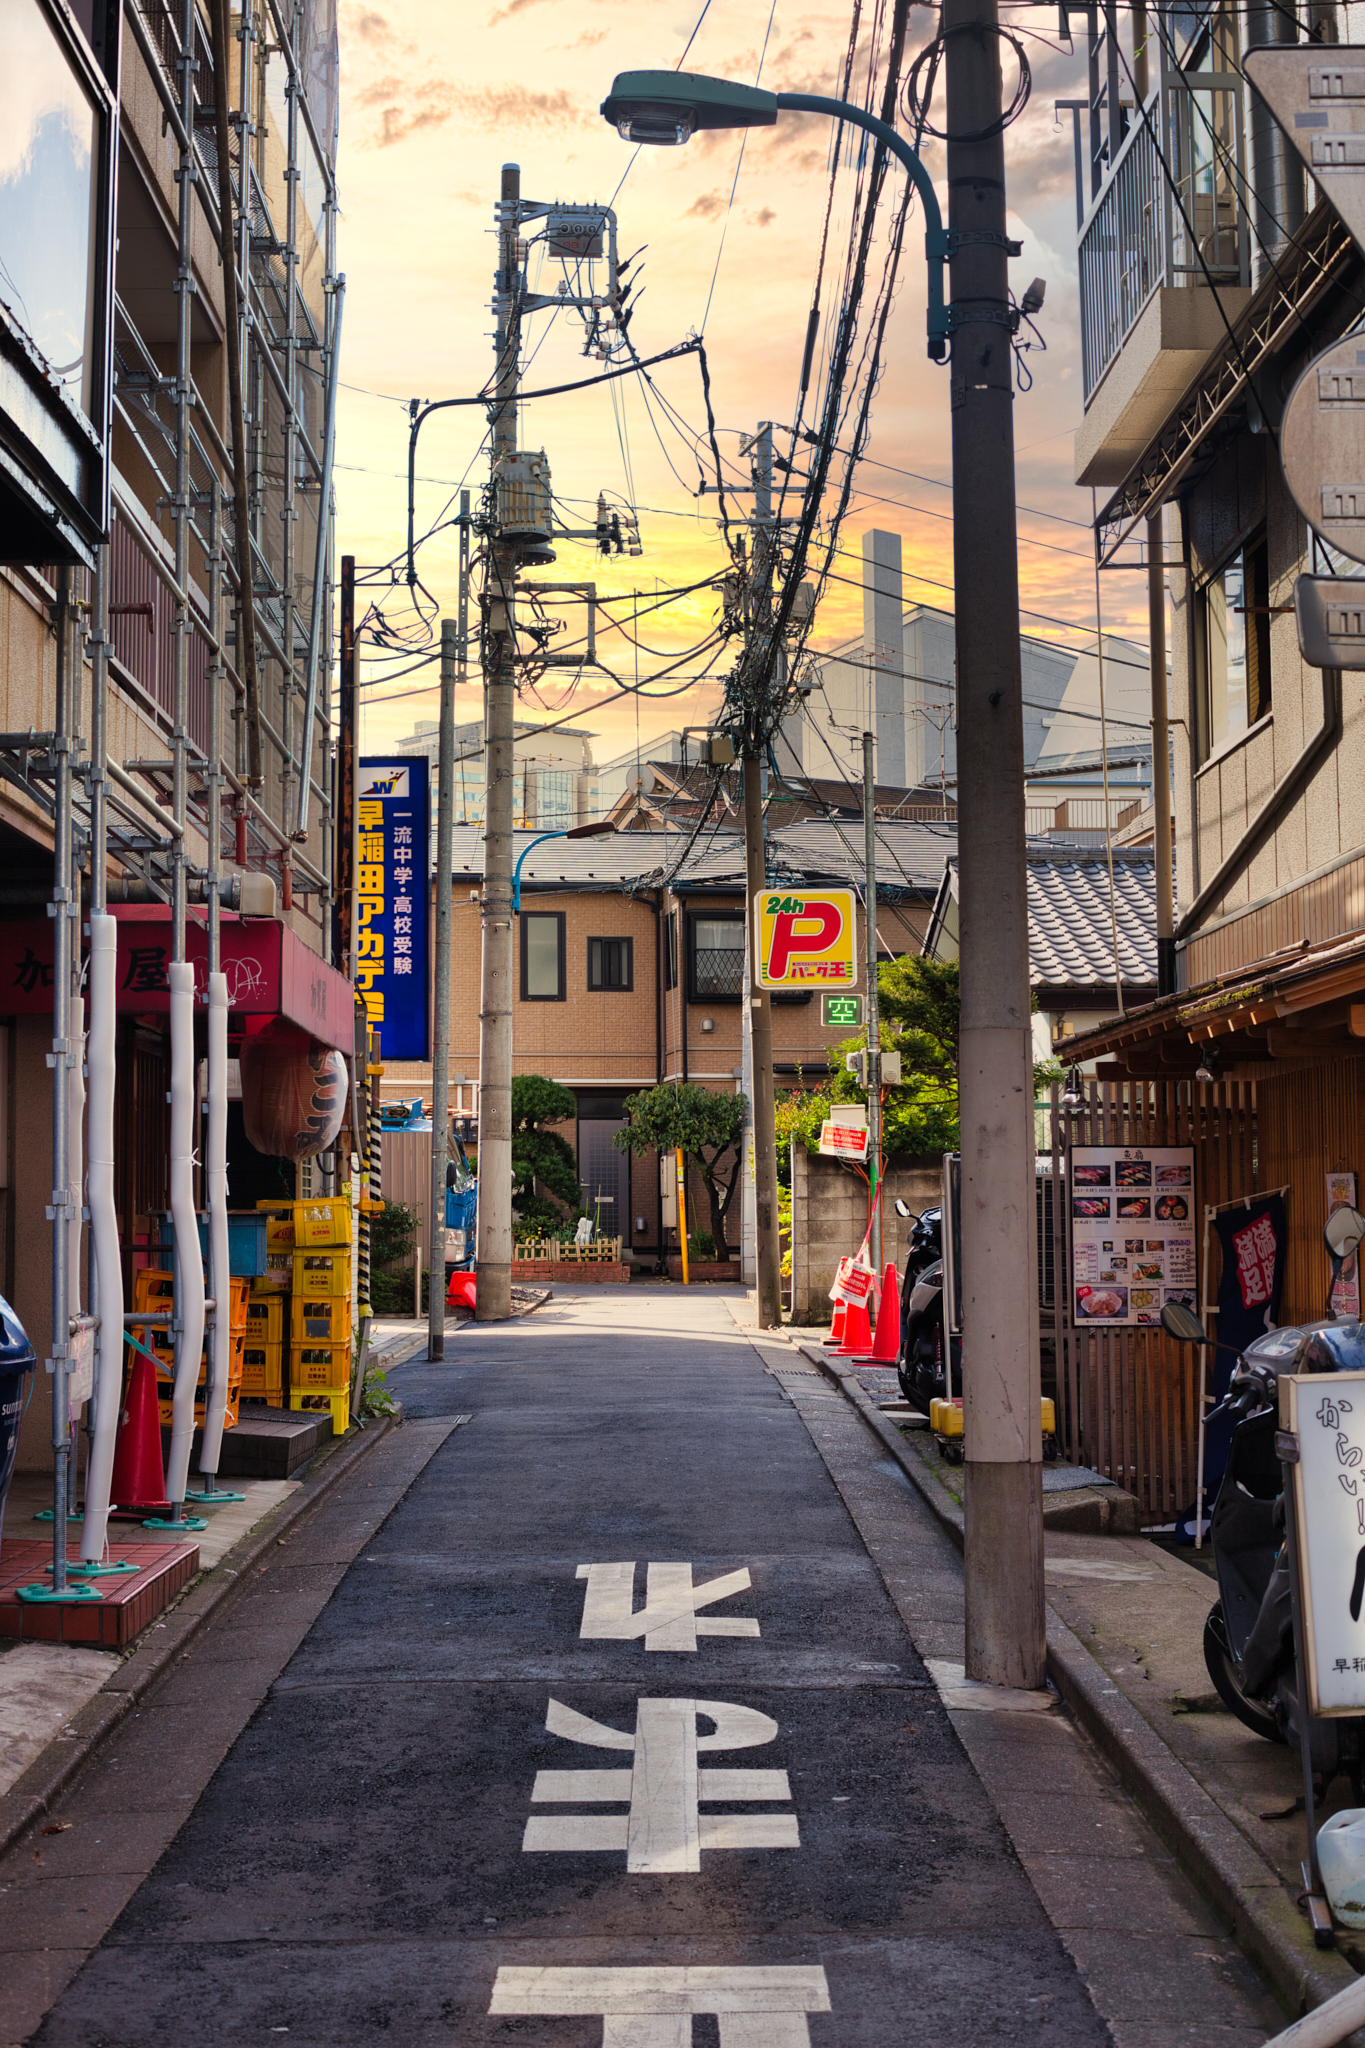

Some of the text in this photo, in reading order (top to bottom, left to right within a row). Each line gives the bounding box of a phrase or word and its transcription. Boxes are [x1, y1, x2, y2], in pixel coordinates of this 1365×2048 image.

[393, 812, 413, 975] 一流中学・高校受験
[766, 897, 805, 914] 24h
[768, 901, 843, 980] P
[12, 946, 171, 994] 加屋
[791, 961, 847, 978] パーク王
[828, 997, 857, 1024] 空
